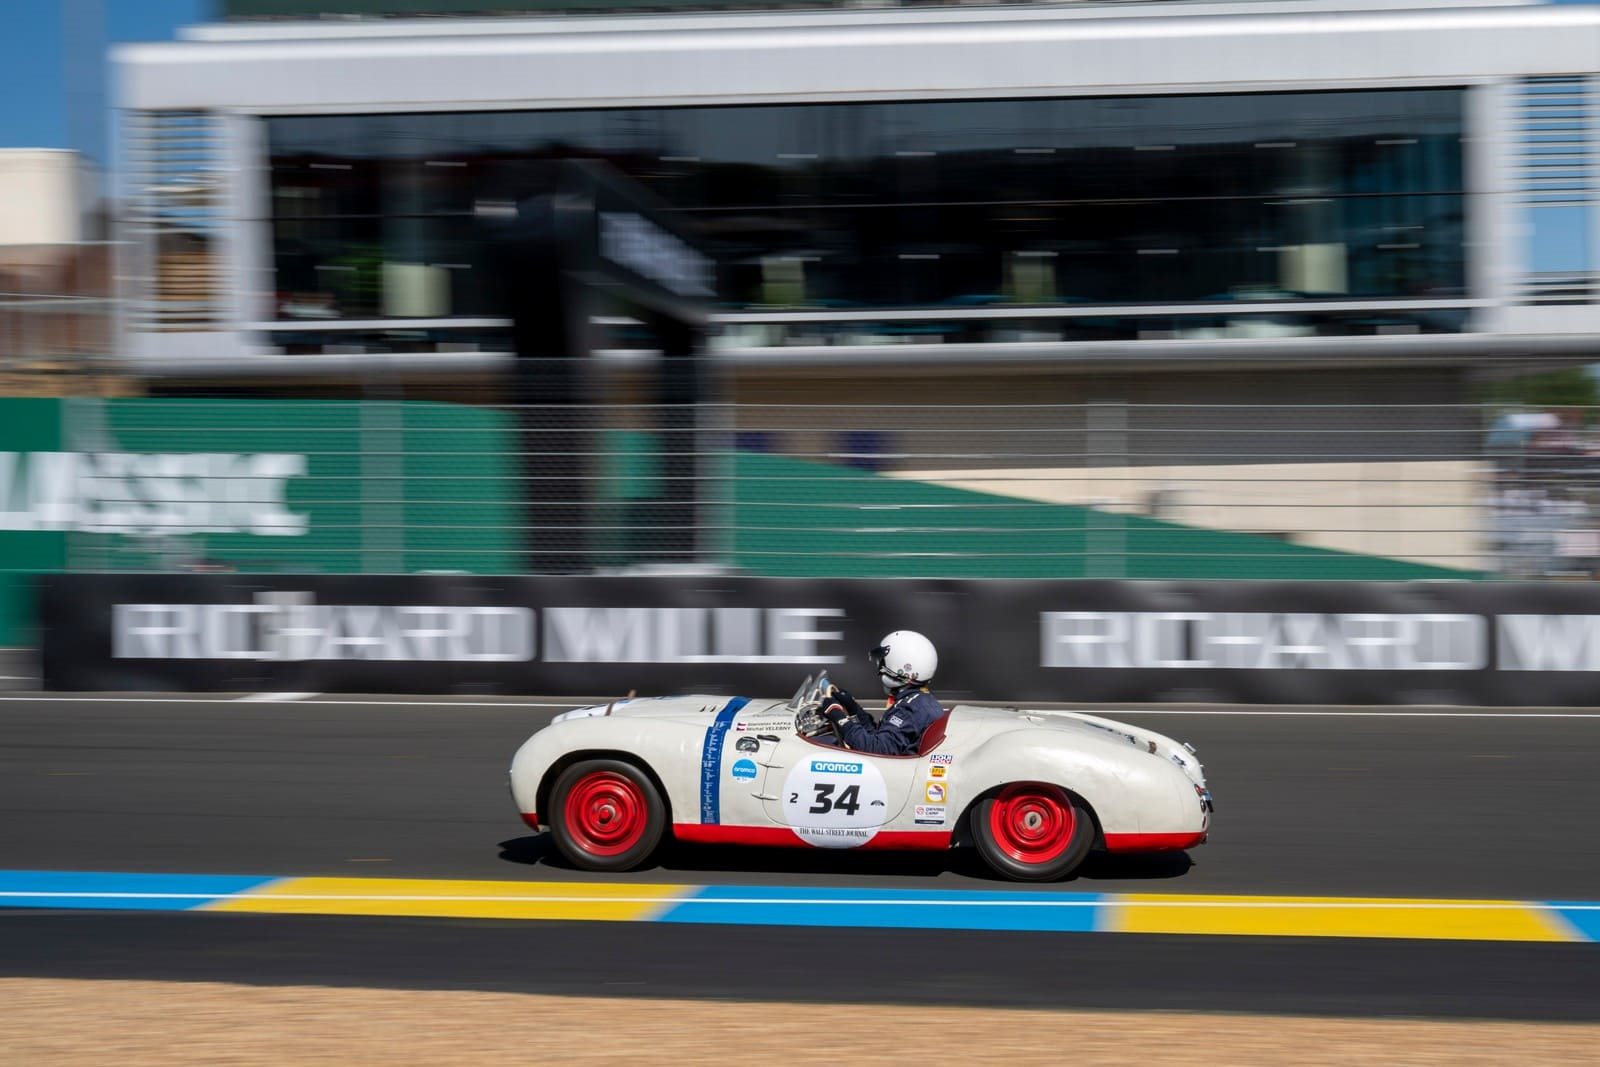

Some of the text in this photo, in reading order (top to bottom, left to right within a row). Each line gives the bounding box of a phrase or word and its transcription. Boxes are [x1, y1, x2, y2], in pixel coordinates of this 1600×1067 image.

[111, 603, 847, 664] RICHARD WILLE
[1040, 611, 1490, 670] RICHARD
[815, 762, 858, 772] aramco
[789, 792, 799, 803] 2
[809, 783, 860, 816] 34
[826, 828, 845, 836] STREET
